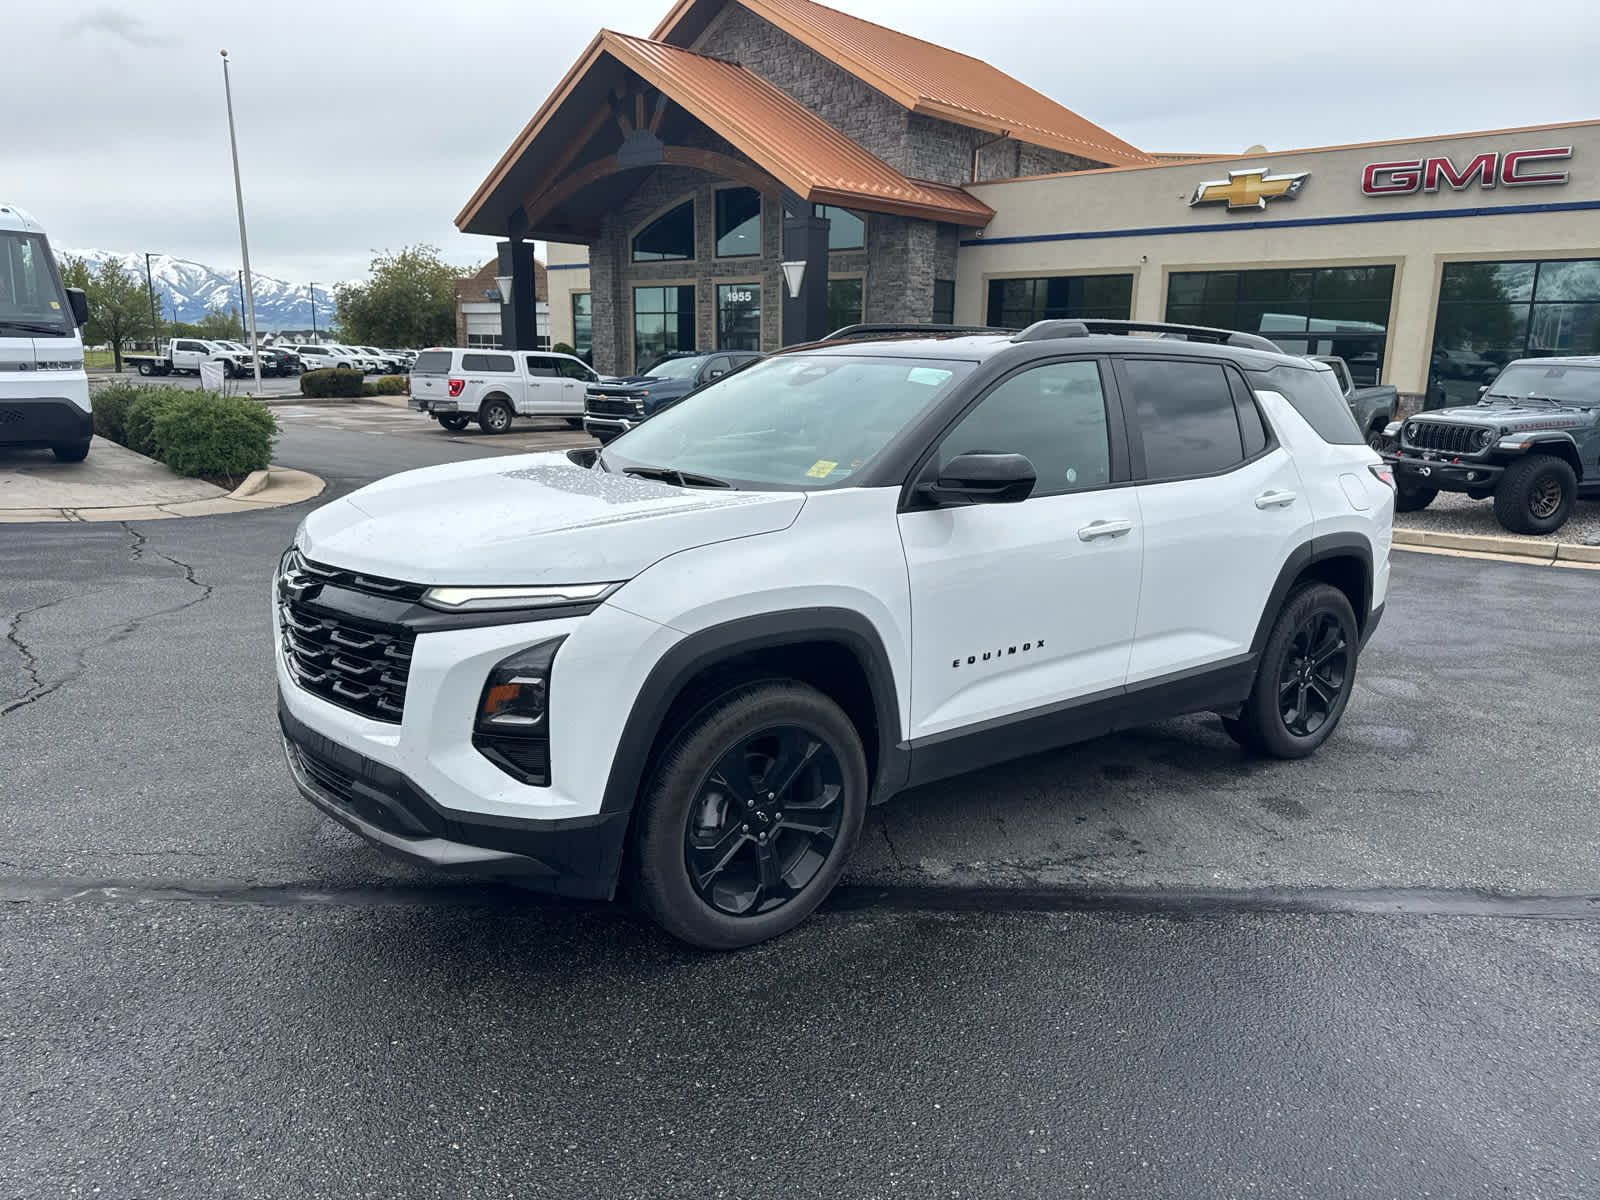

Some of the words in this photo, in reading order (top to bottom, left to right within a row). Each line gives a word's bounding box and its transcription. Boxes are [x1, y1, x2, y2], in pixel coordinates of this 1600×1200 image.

[1361, 145, 1573, 197] GMC
[727, 291, 752, 302] 1955
[952, 639, 1045, 668] EQUINOX
